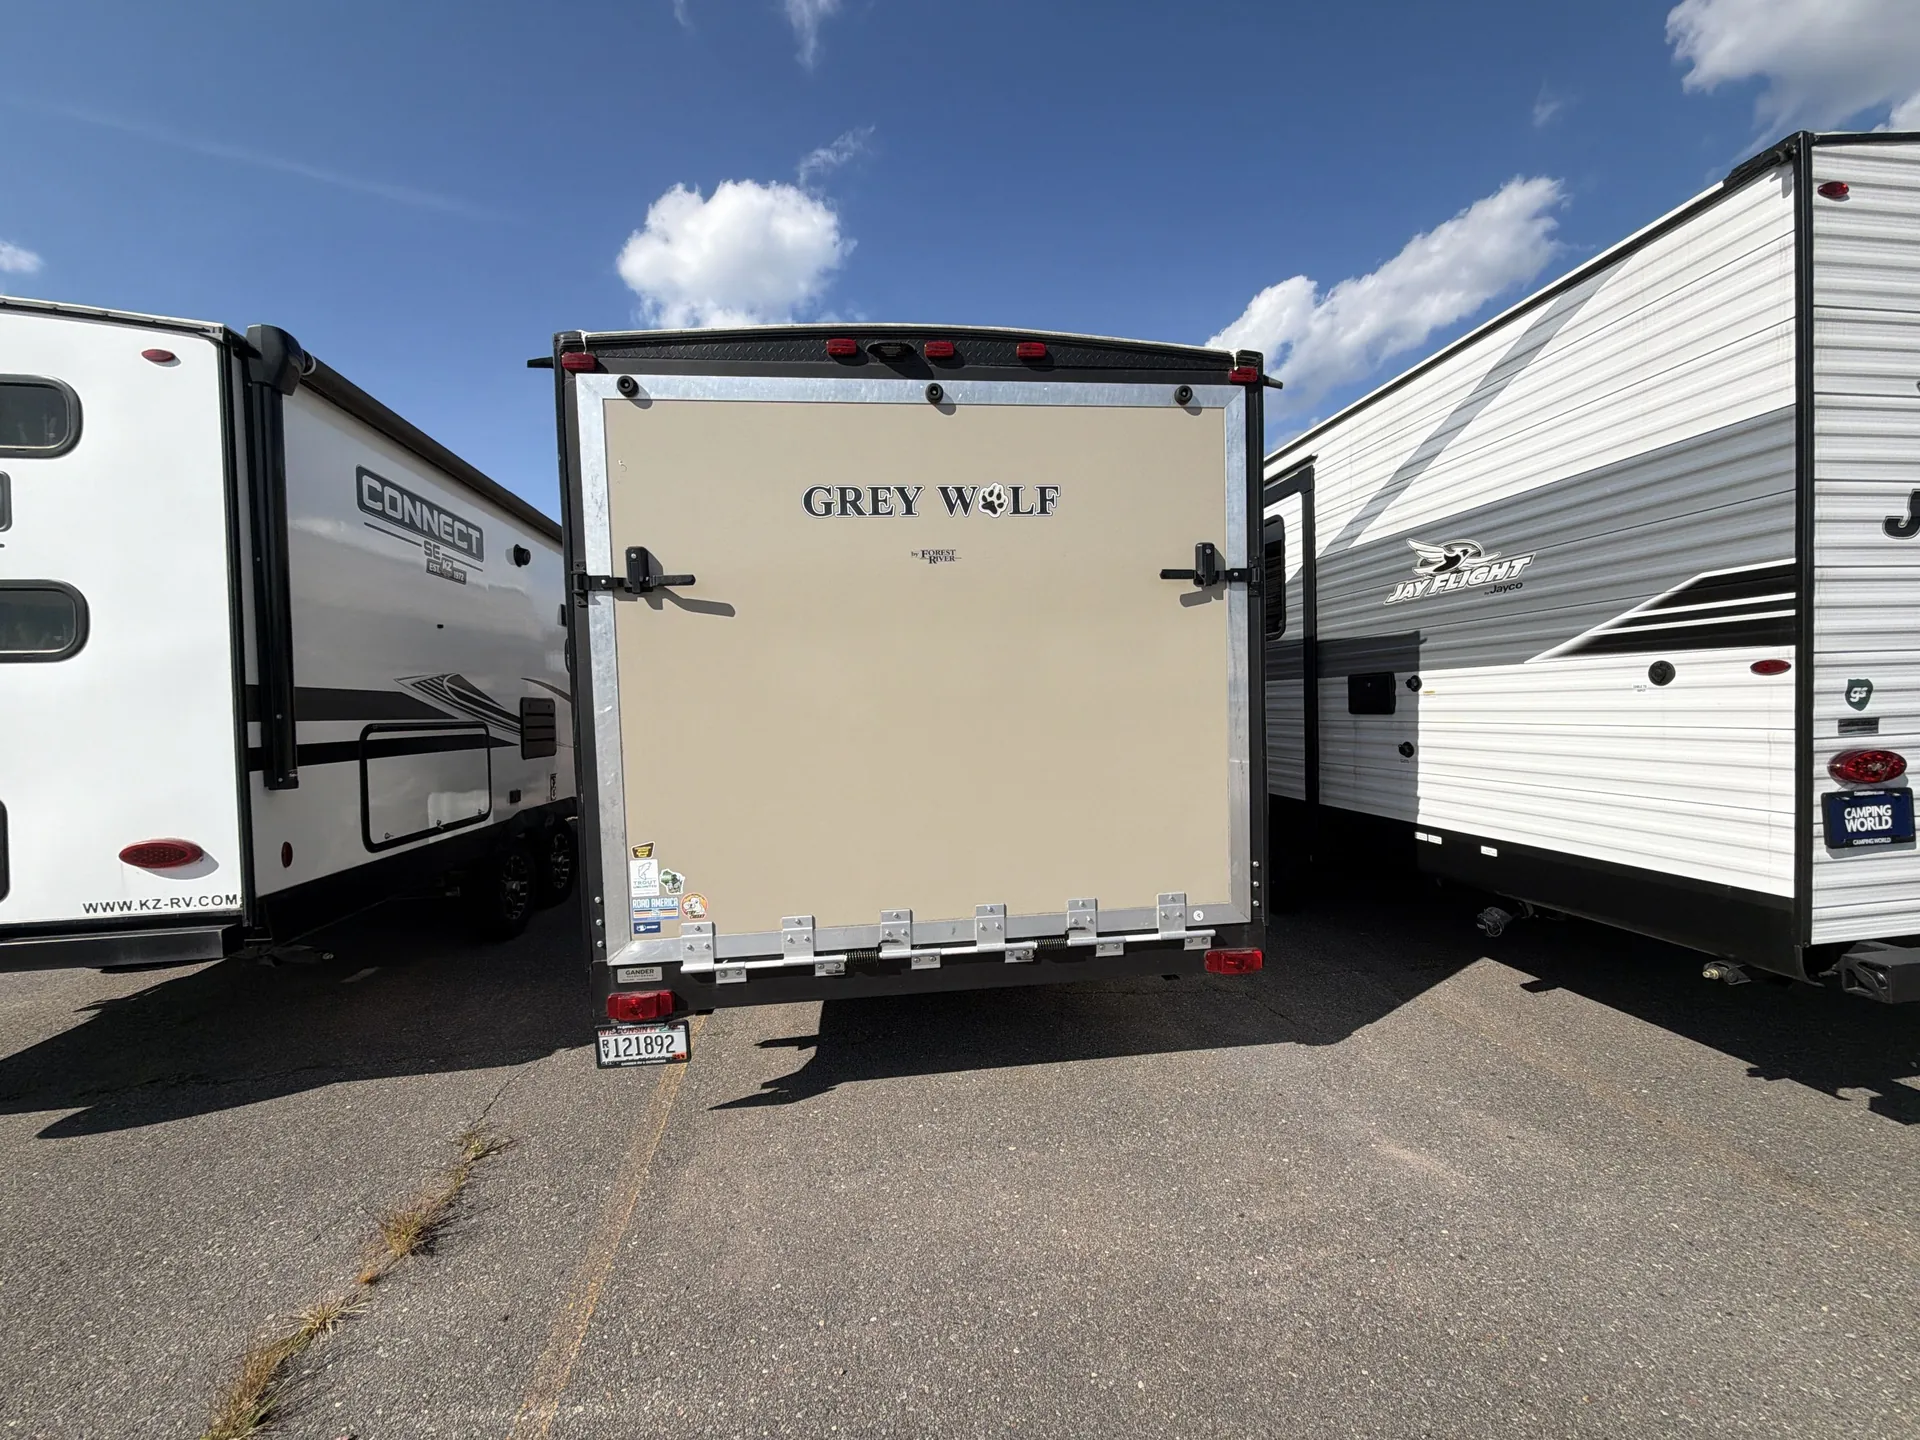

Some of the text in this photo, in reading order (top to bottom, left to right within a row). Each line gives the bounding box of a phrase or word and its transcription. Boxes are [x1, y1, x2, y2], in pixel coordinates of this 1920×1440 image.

[802, 484, 923, 518] GREY
[362, 474, 480, 555] CONNECT
[423, 540, 441, 560] SE
[920, 549, 956, 559] FOREST
[928, 555, 956, 564] RIVER
[1385, 553, 1536, 604] JAY FLIGHT
[1489, 582, 1523, 594] Jayco
[1850, 687, 1868, 702] gs
[1844, 804, 1892, 819] CAMPING
[1844, 816, 1892, 832] WORLD
[82, 893, 238, 914] WWW.KZ-RV.COM
[632, 897, 679, 909] ROAD AMERICA
[625, 968, 655, 976] GANDER
[613, 1034, 676, 1058] 121892
